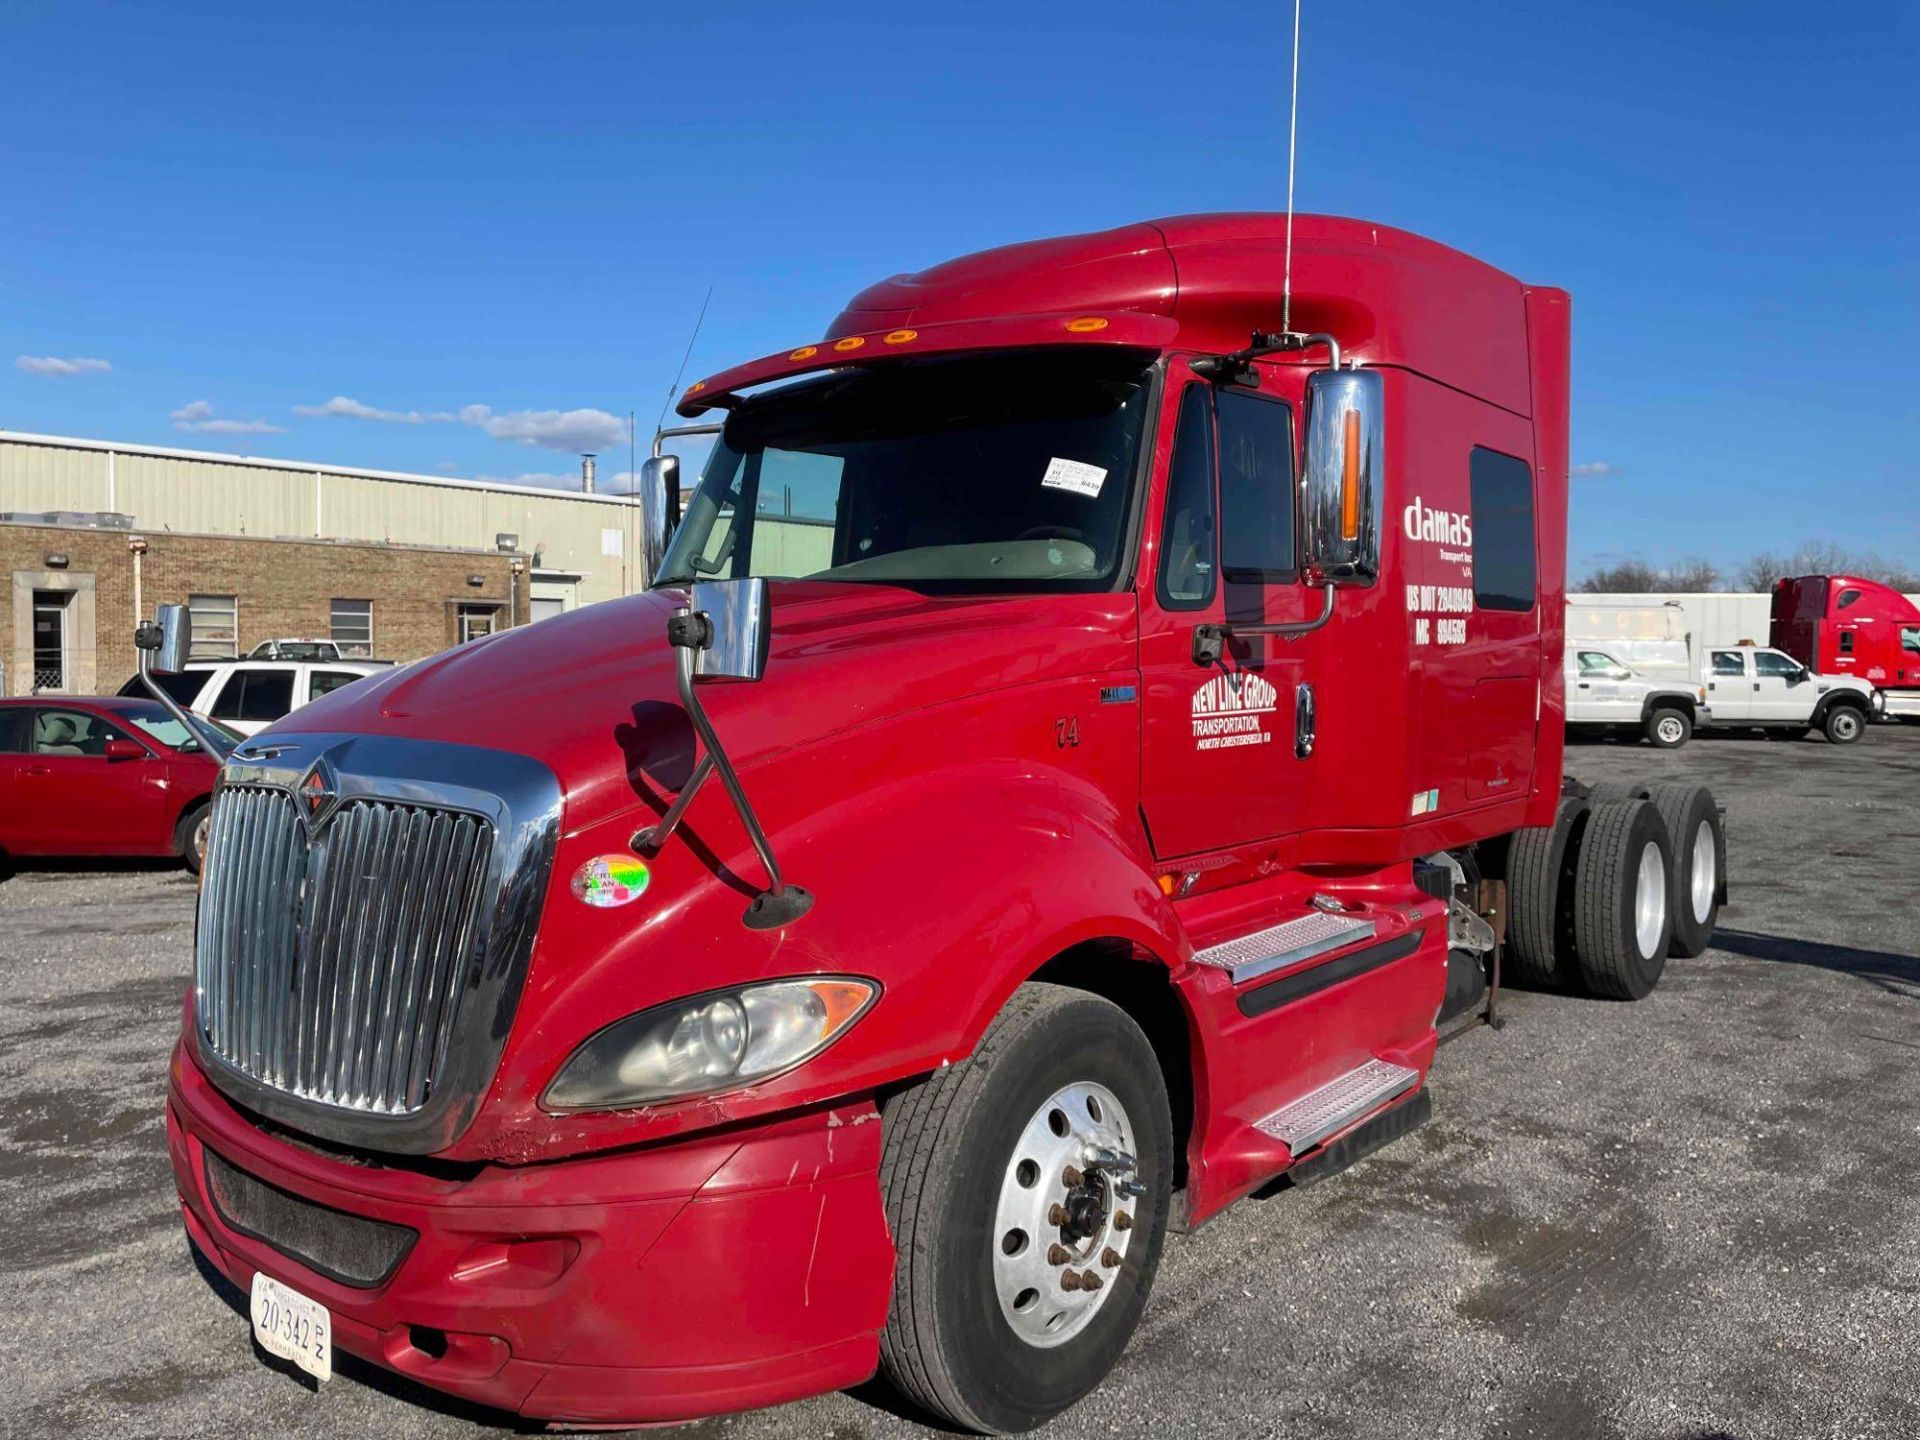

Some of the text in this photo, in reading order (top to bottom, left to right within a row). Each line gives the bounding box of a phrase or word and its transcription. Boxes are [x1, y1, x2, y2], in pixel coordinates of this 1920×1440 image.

[1404, 496, 1473, 547] damas
[1440, 549, 1464, 564] Transport
[1462, 566, 1473, 578] VA
[1406, 585, 1419, 612] US
[1420, 585, 1437, 612] DOT
[1416, 618, 1430, 645] MC
[1192, 673, 1277, 713] NEW LINE GROUP
[1054, 716, 1081, 749] 74
[1197, 737, 1221, 751] NORTH
